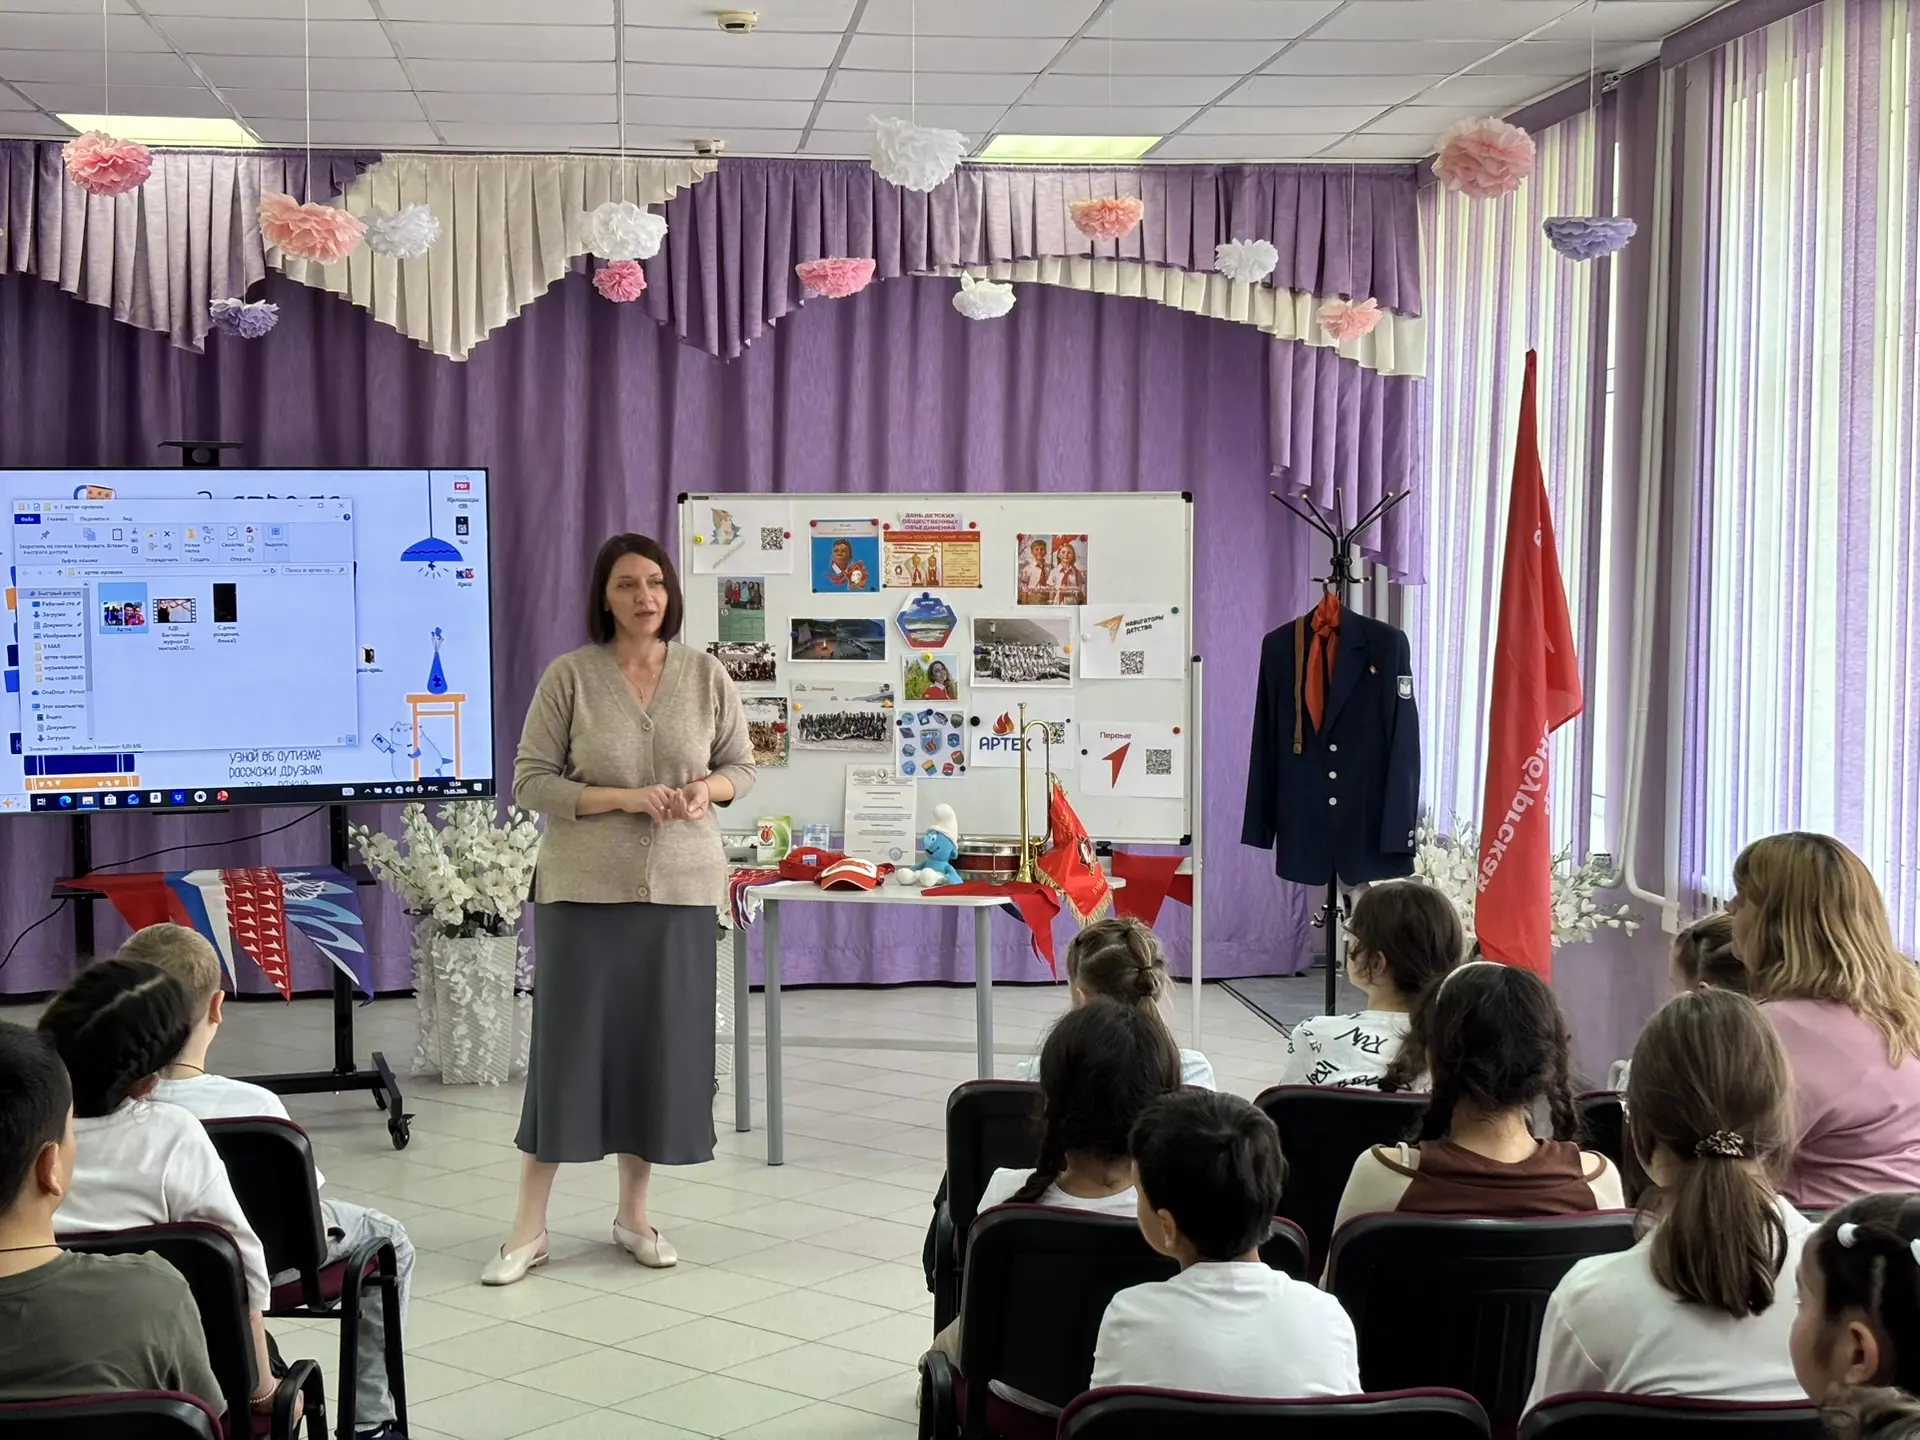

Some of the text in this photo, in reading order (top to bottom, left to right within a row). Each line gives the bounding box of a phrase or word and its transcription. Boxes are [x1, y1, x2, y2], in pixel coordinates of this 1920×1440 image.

[1125, 615, 1164, 627] НАВИГАТОРЫ
[1126, 624, 1152, 635] ДЕТСТВА
[1100, 731, 1132, 740] Первые
[979, 736, 1033, 752] АРТЕК
